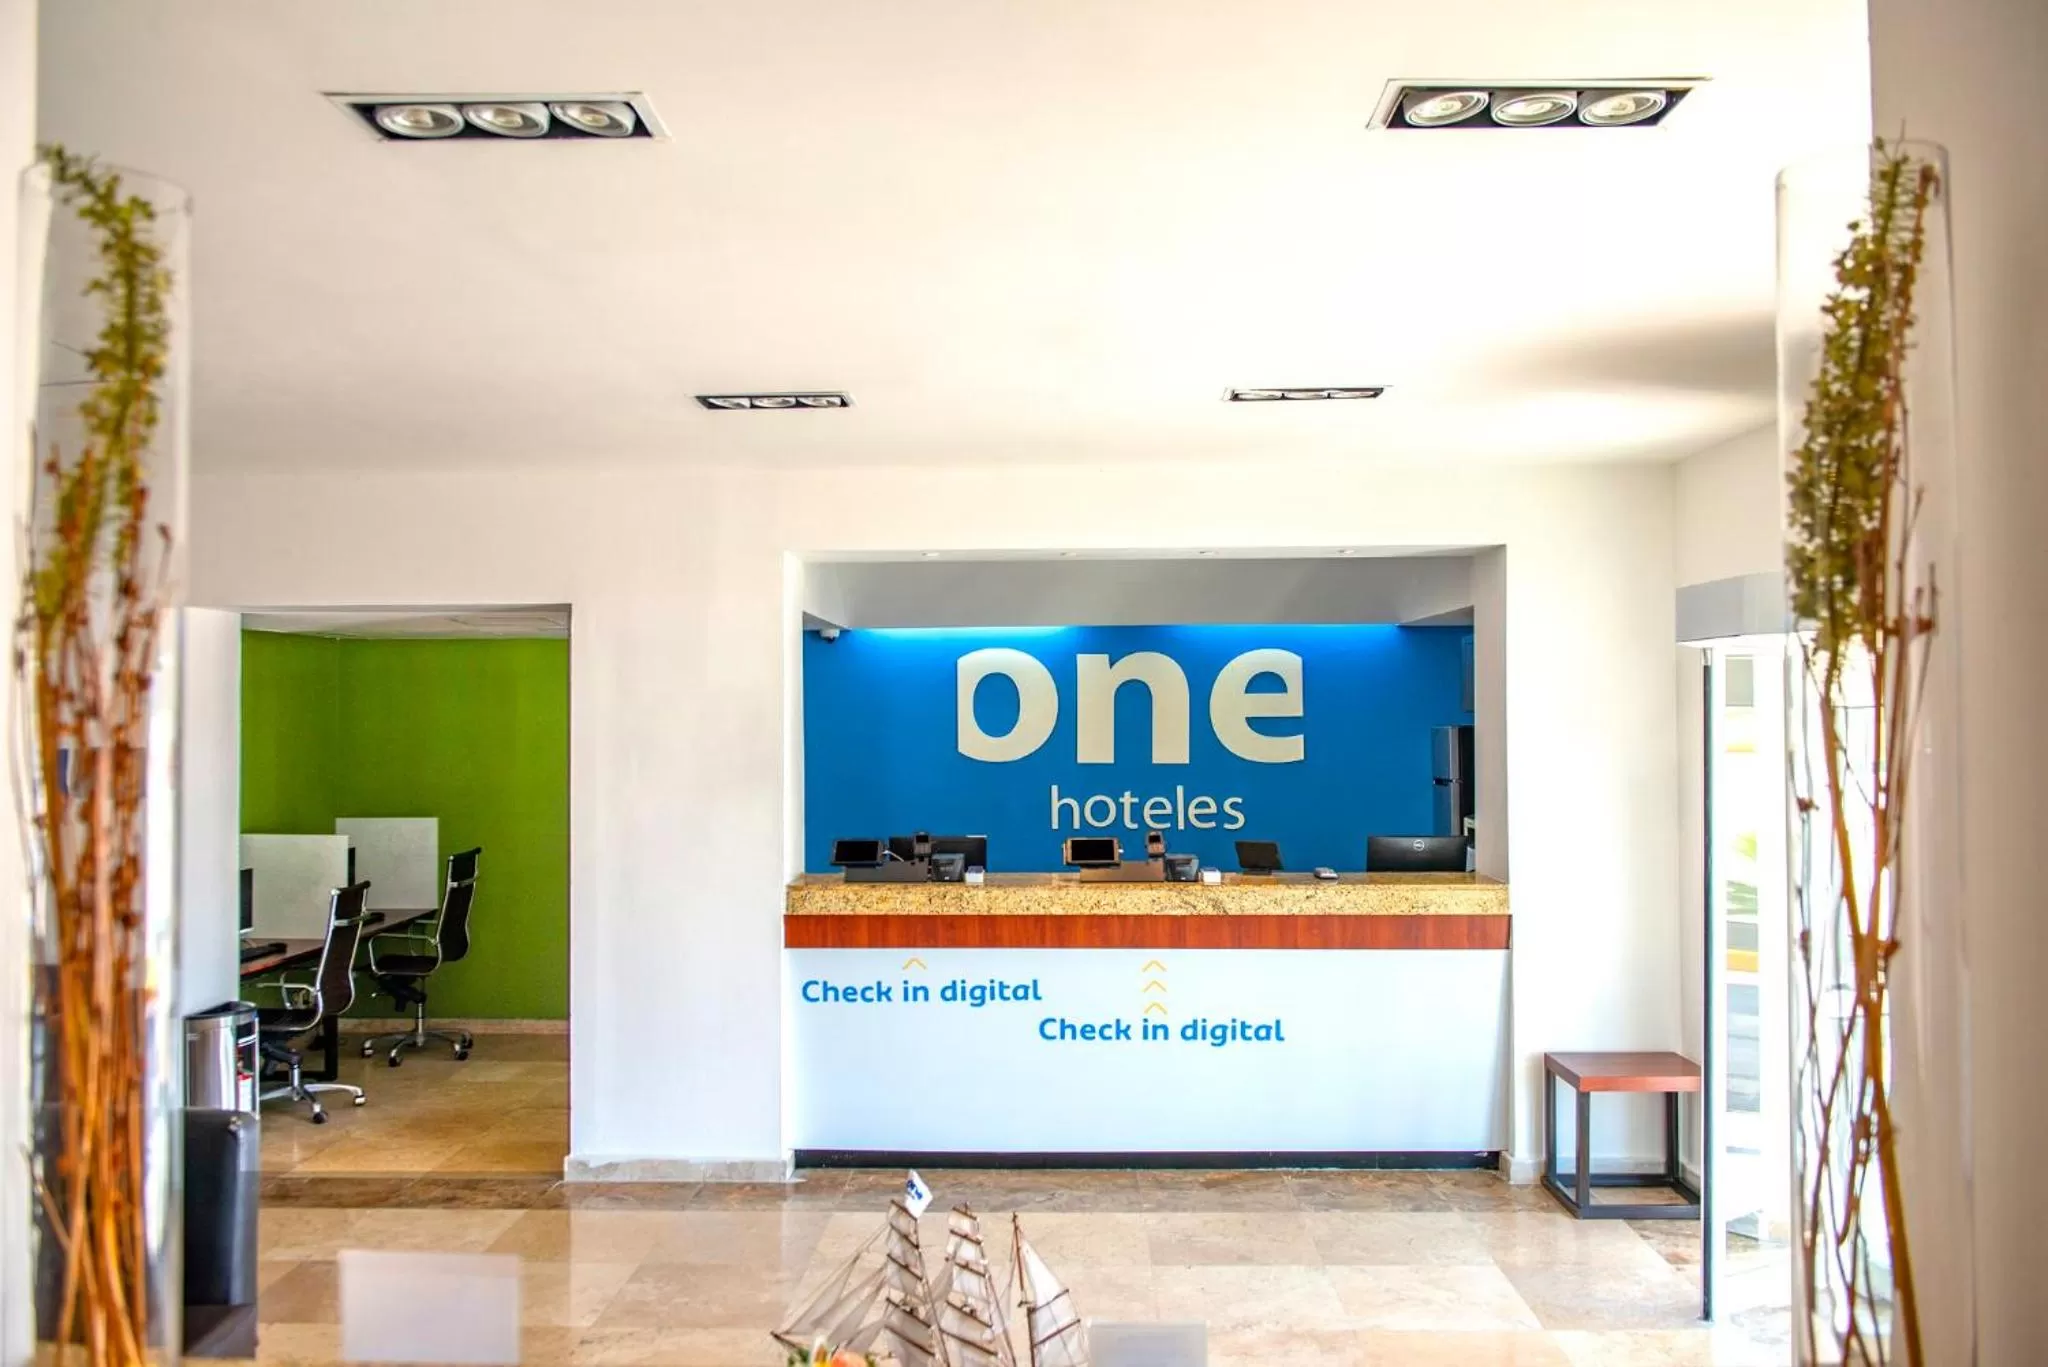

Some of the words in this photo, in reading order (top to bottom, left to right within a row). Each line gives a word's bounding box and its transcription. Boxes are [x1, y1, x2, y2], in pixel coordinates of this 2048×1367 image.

[957, 648, 1304, 764] one
[1050, 785, 1245, 831] hoteles
[802, 980, 893, 1003] Check
[903, 980, 929, 1003] in
[940, 979, 1043, 1008] digital
[1039, 1018, 1132, 1042] Check
[1143, 1018, 1170, 1041] in
[1181, 1018, 1285, 1047] digital
